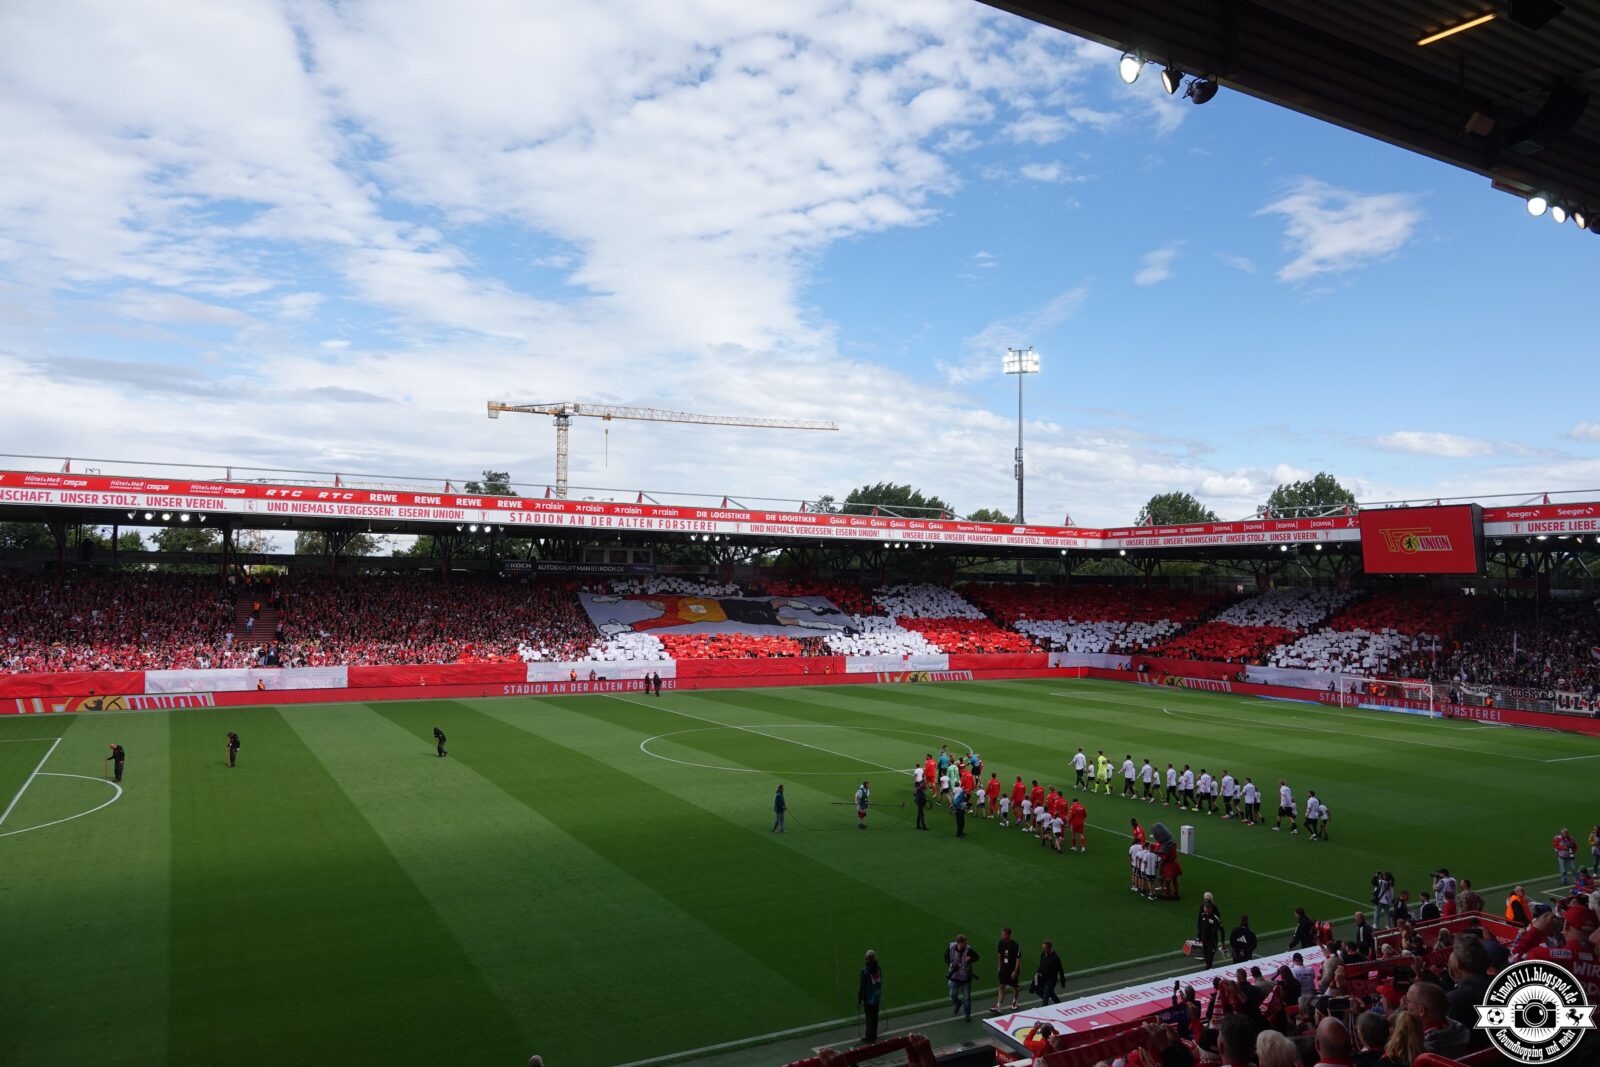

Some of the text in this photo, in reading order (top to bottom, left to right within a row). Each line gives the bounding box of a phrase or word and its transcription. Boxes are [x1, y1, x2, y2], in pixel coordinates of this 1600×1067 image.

[265, 489, 303, 498] RTC
[318, 491, 354, 500] RTC
[369, 493, 398, 503] REWE
[60, 493, 99, 504] UNSER
[102, 495, 140, 506] STOLZ.
[146, 497, 182, 508] UNSER
[186, 498, 228, 510] VEREIN.
[414, 496, 441, 504] REWE
[456, 498, 483, 507] REWE
[497, 500, 523, 509] REWE
[267, 502, 465, 520] UND NIEMALS VERGESSEN: EISERN UNION!
[541, 503, 565, 511] raisin
[582, 504, 604, 513] raisin
[619, 506, 642, 515] raisin
[658, 508, 679, 516] raisin
[710, 511, 751, 520] LOGISTIKER
[1506, 510, 1532, 518] Seeger
[1557, 508, 1585, 516] Seeger
[509, 512, 564, 524] STADION
[569, 515, 585, 525] AN
[591, 516, 612, 526] DER
[618, 518, 653, 528] ALTEN
[778, 515, 817, 523] LOGISTIKER
[1528, 520, 1600, 533] UNSERE LIEBE.
[766, 525, 794, 534] NIEMALS
[795, 526, 834, 536] VERGESSEN:
[835, 528, 858, 537] EISERN
[858, 529, 880, 538] UNION!
[902, 531, 924, 540] UNSERE
[925, 532, 942, 541] LIEBE.
[944, 533, 966, 542] UNSERE
[967, 534, 1004, 543] MANNSCHAFT.
[1006, 536, 1024, 544] UNSER
[1042, 537, 1059, 545] UNSER
[1126, 538, 1145, 546] UNSERE
[1163, 537, 1183, 545] UNSERE
[1226, 534, 1246, 543] UNSER
[1270, 532, 1291, 542] UNSER
[1293, 532, 1320, 541] VEREIN.
[503, 684, 550, 695] STADION
[553, 683, 566, 693] AN
[570, 682, 589, 692] DER
[593, 681, 623, 691] ALTEN
